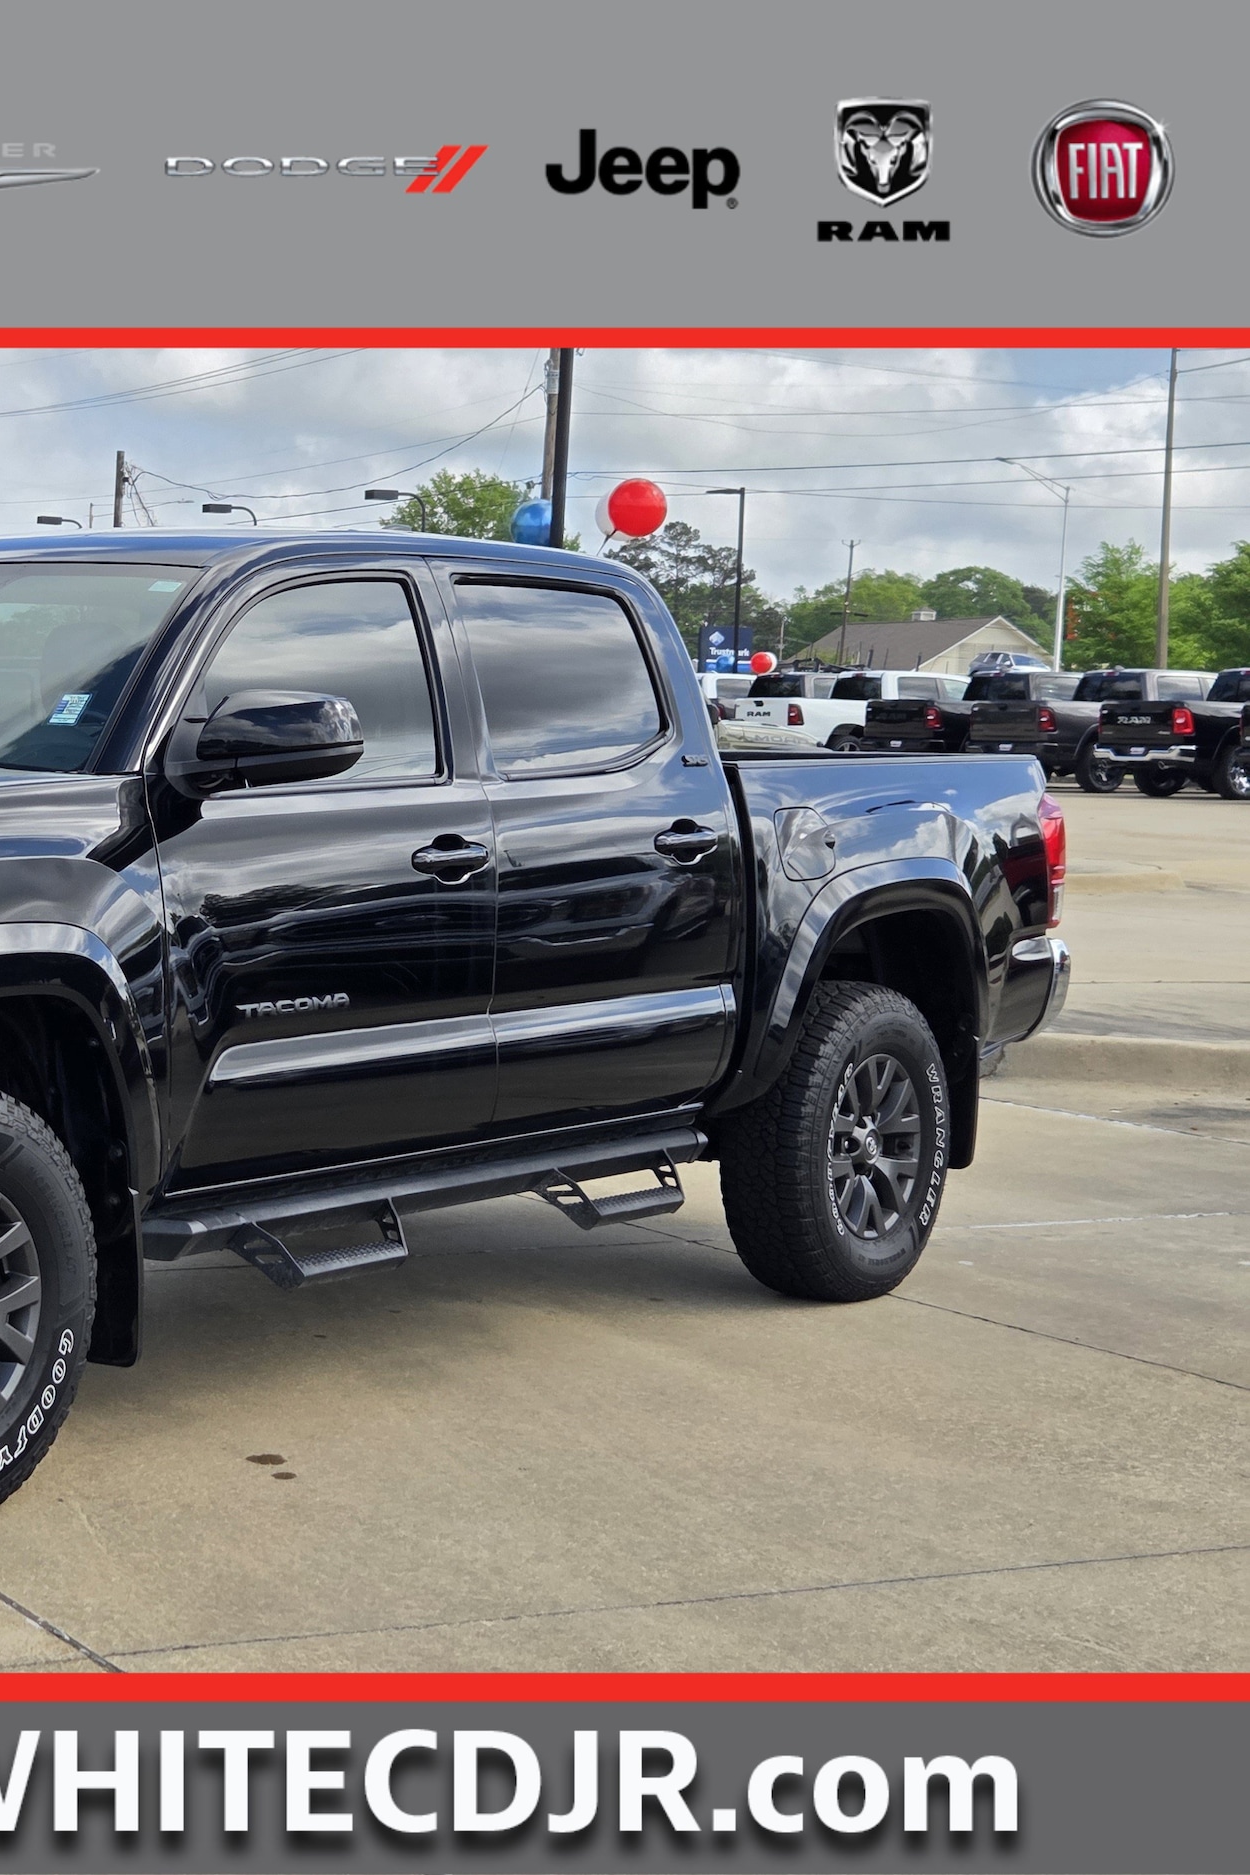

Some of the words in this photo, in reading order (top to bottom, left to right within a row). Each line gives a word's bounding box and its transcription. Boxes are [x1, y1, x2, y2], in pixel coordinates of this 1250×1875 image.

[1116, 715, 1152, 725] RAM
[235, 992, 350, 1019] TACOMA
[919, 1062, 947, 1227] WRANGLER
